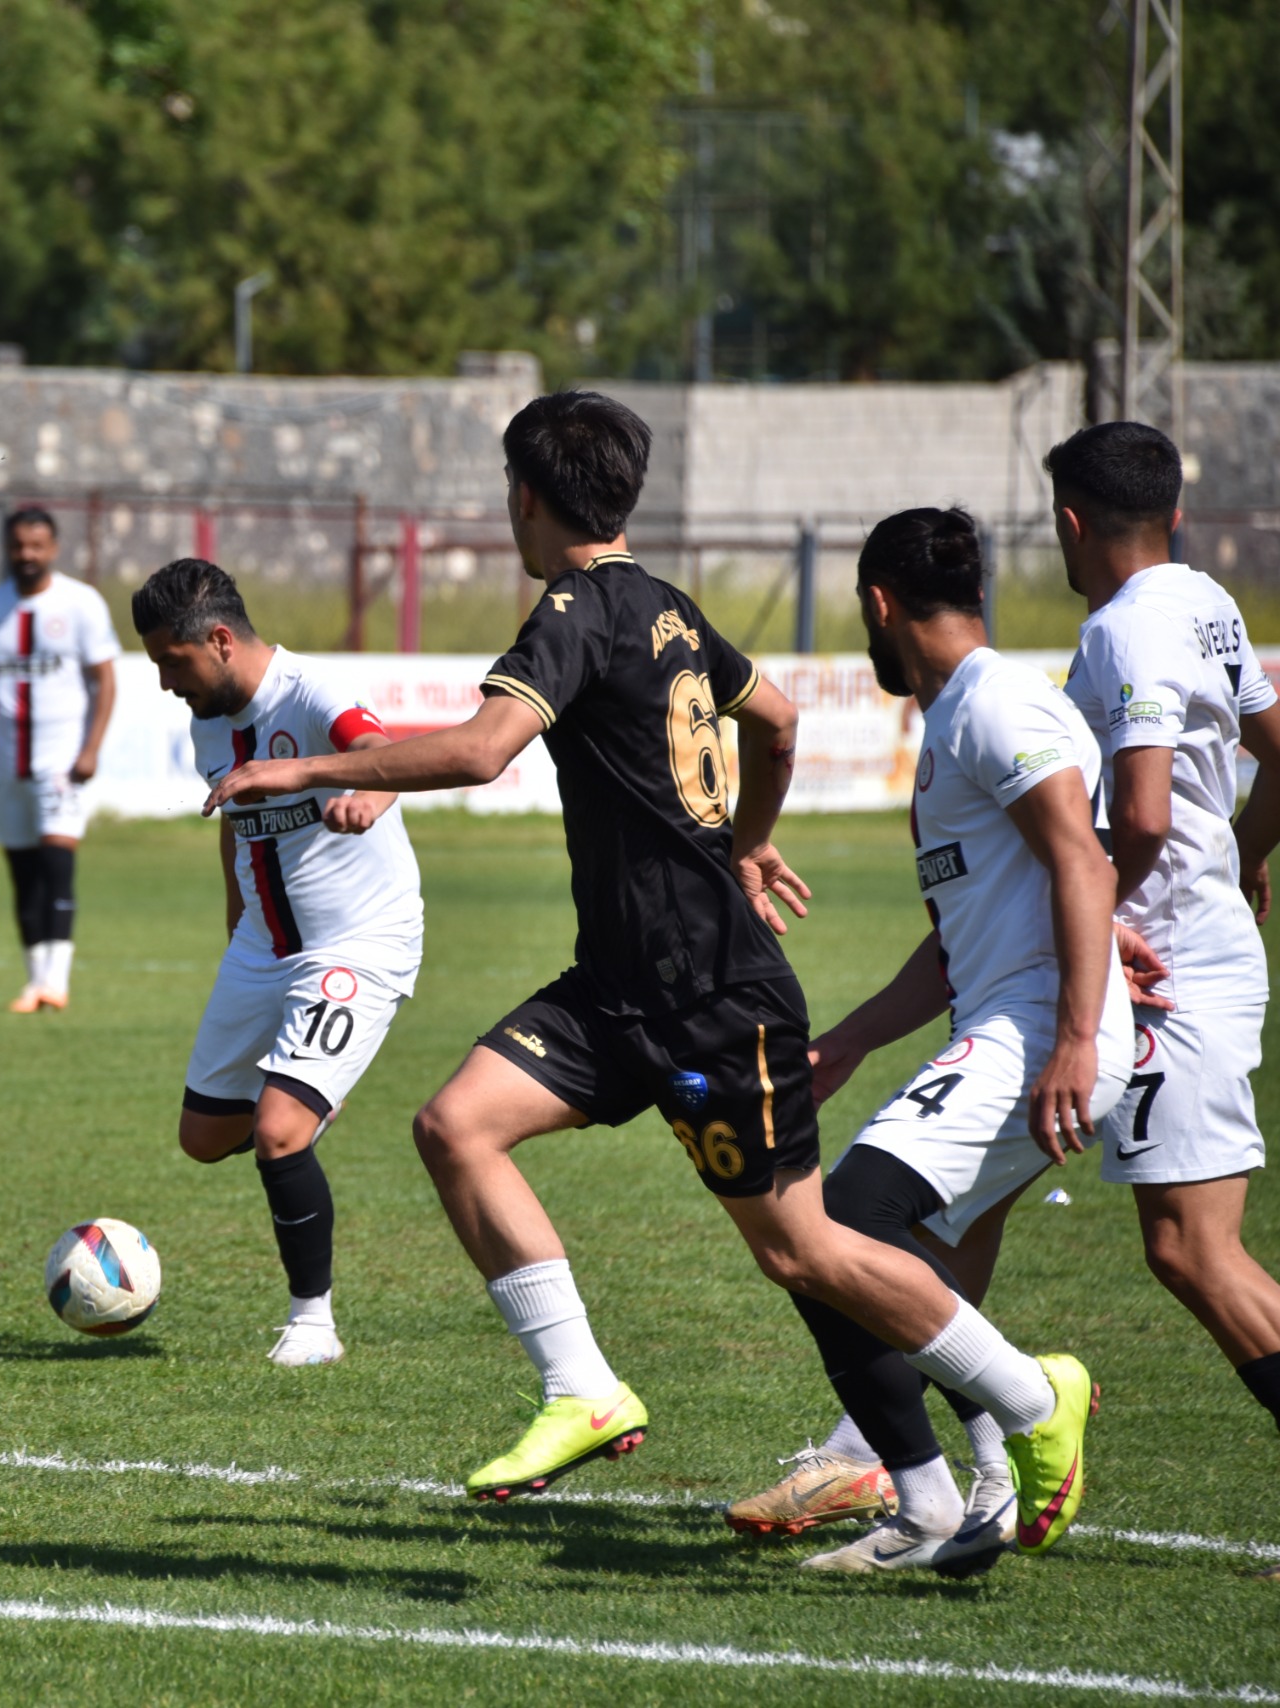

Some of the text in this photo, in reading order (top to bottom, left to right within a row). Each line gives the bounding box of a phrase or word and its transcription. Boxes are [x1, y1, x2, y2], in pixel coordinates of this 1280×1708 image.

[666, 669, 729, 829] 6
[1130, 716, 1163, 725] PETROL
[302, 999, 354, 1057] 10
[1125, 1071, 1166, 1141] 7
